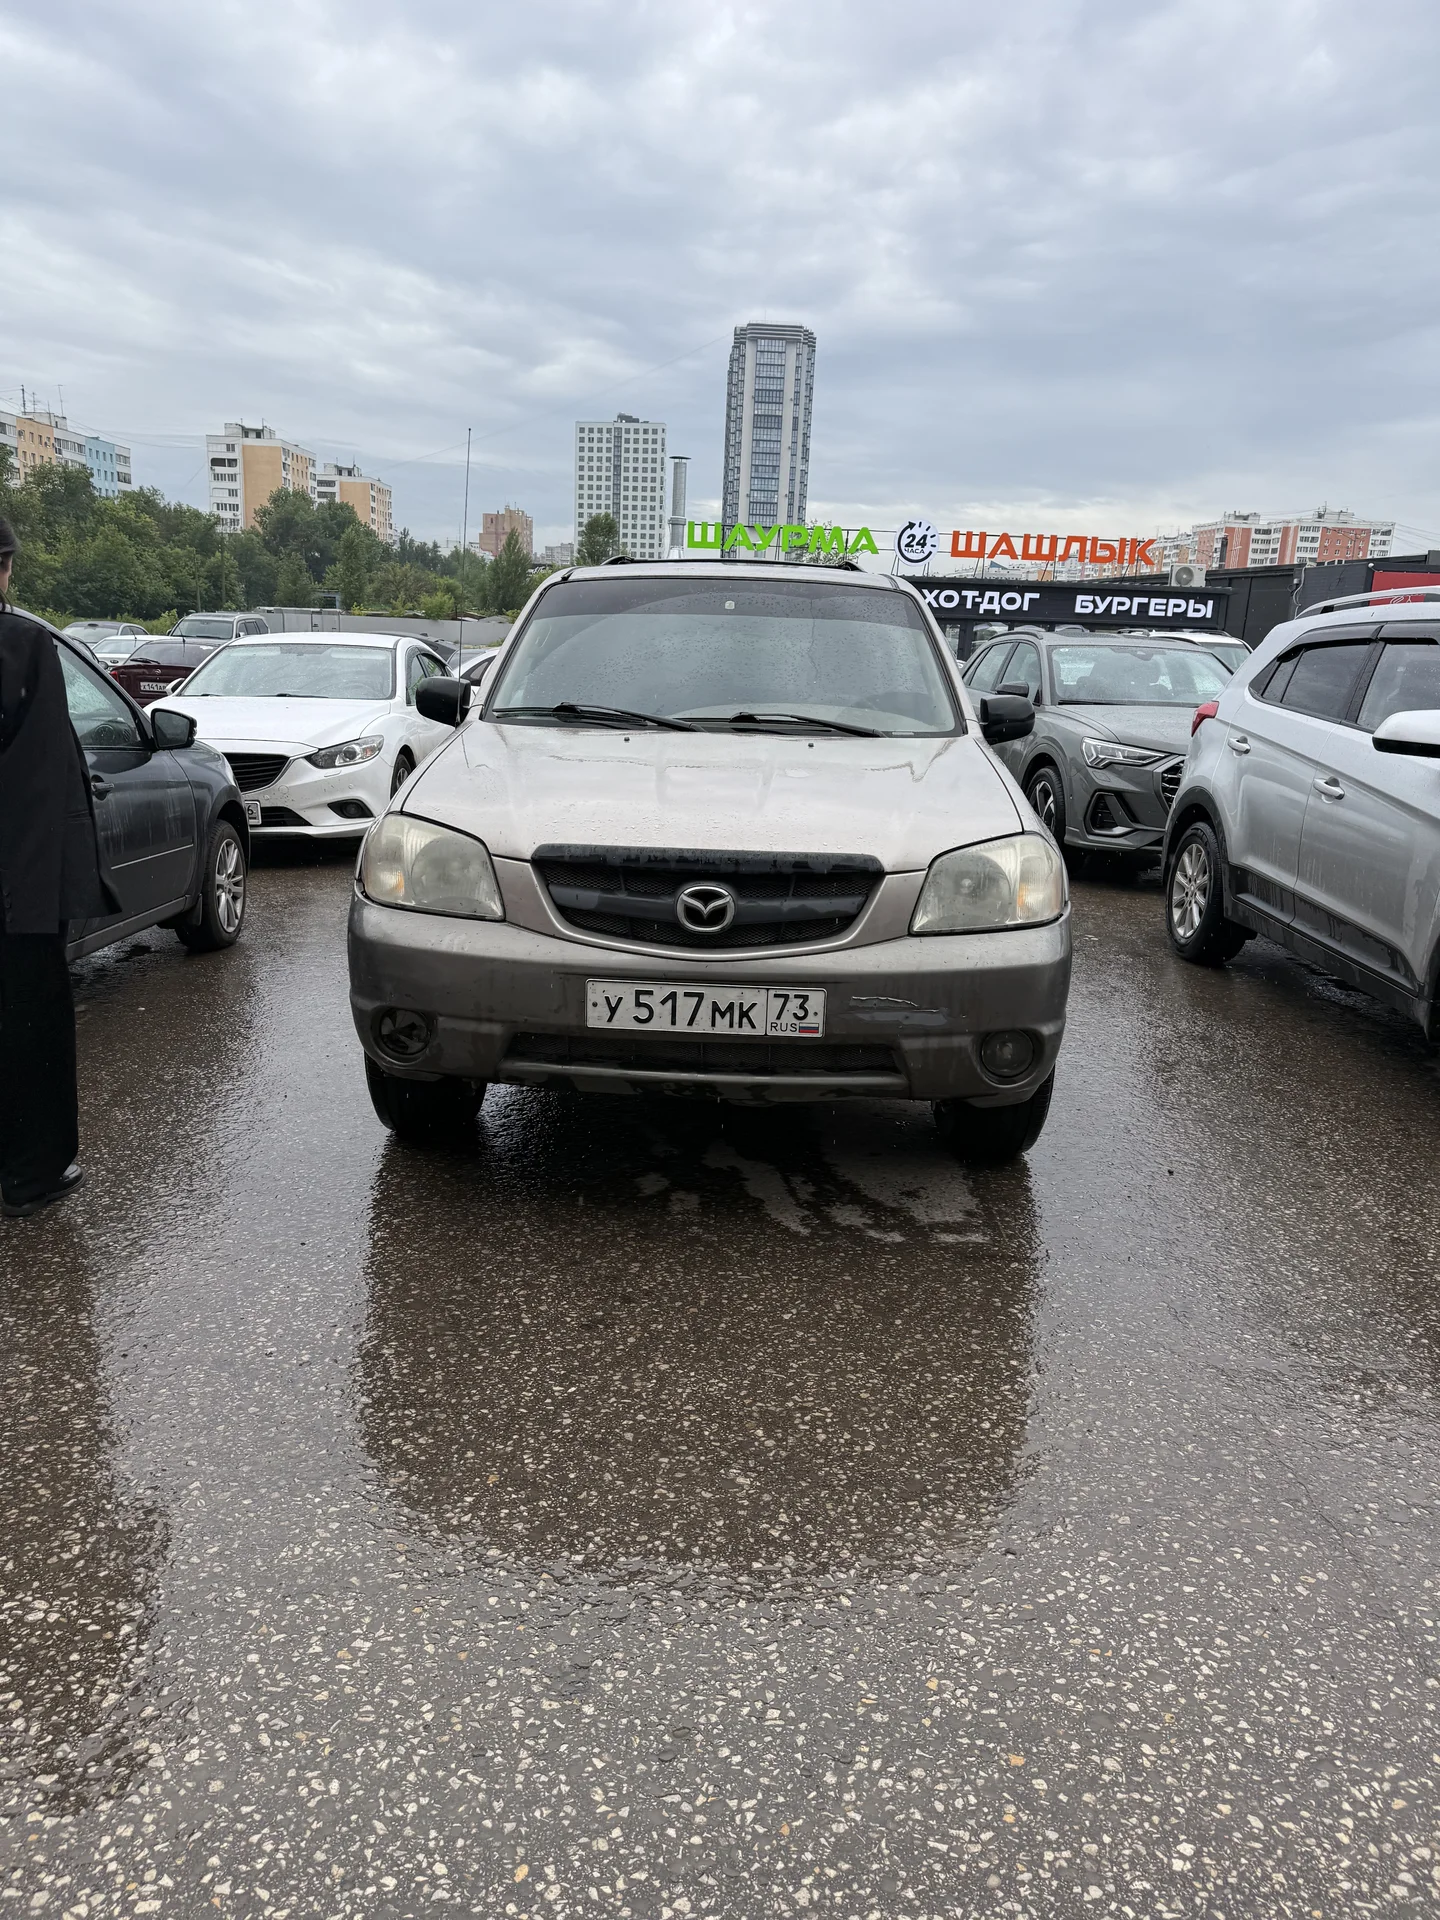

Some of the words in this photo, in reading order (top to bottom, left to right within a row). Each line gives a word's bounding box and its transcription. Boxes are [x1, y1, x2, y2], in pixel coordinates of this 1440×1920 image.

[687, 521, 880, 555] ШАУРМА
[904, 533, 928, 548] 24
[950, 530, 1157, 566] ШАШЛЫК
[921, 588, 1040, 615] ХОТ-ДОГ
[1074, 594, 1214, 619] БУРГЕРЫ
[773, 993, 810, 1021] 73
[770, 1022, 798, 1033] RUS
